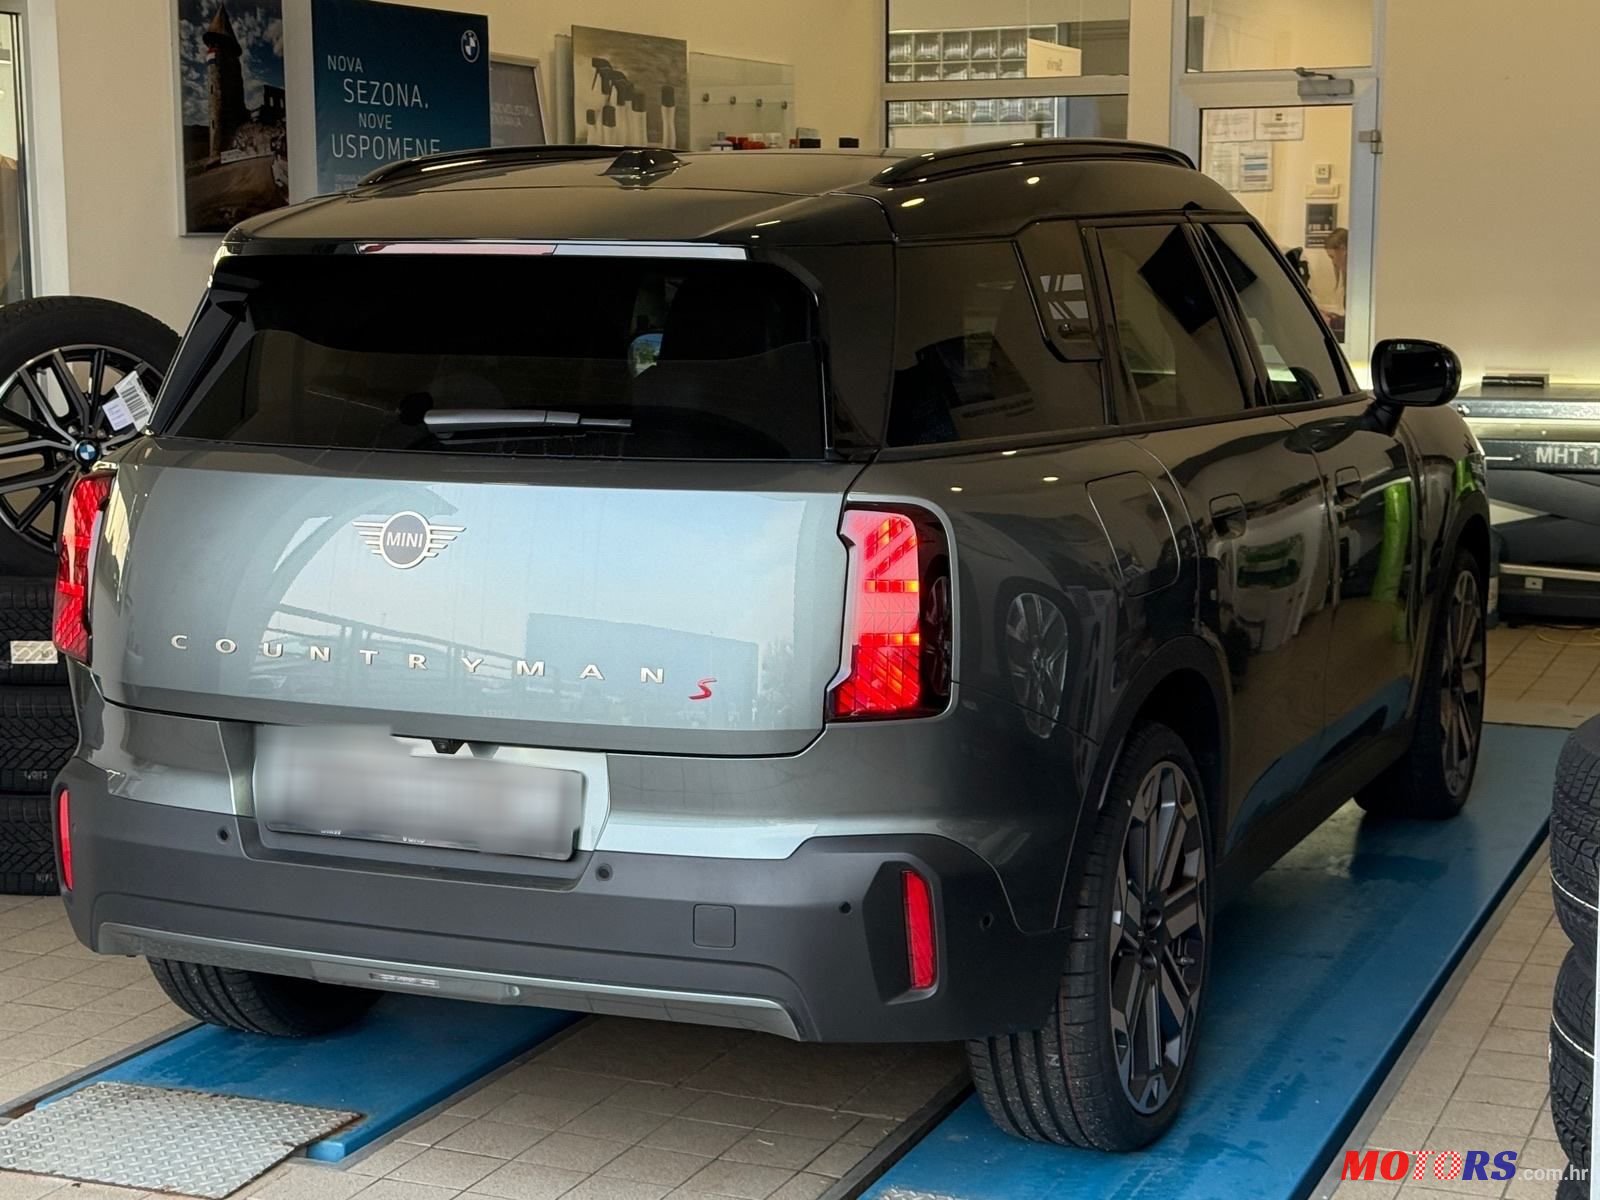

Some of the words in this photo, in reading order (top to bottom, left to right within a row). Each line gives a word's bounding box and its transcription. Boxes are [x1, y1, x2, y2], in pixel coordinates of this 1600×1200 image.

[327, 55, 364, 73] NOVA
[343, 78, 429, 109] SEZONA.
[358, 112, 393, 130] NOVE
[1536, 446, 1584, 464] MHT
[386, 531, 423, 548] MINI
[171, 634, 664, 684] COUNTRYMAN
[687, 676, 718, 700] S
